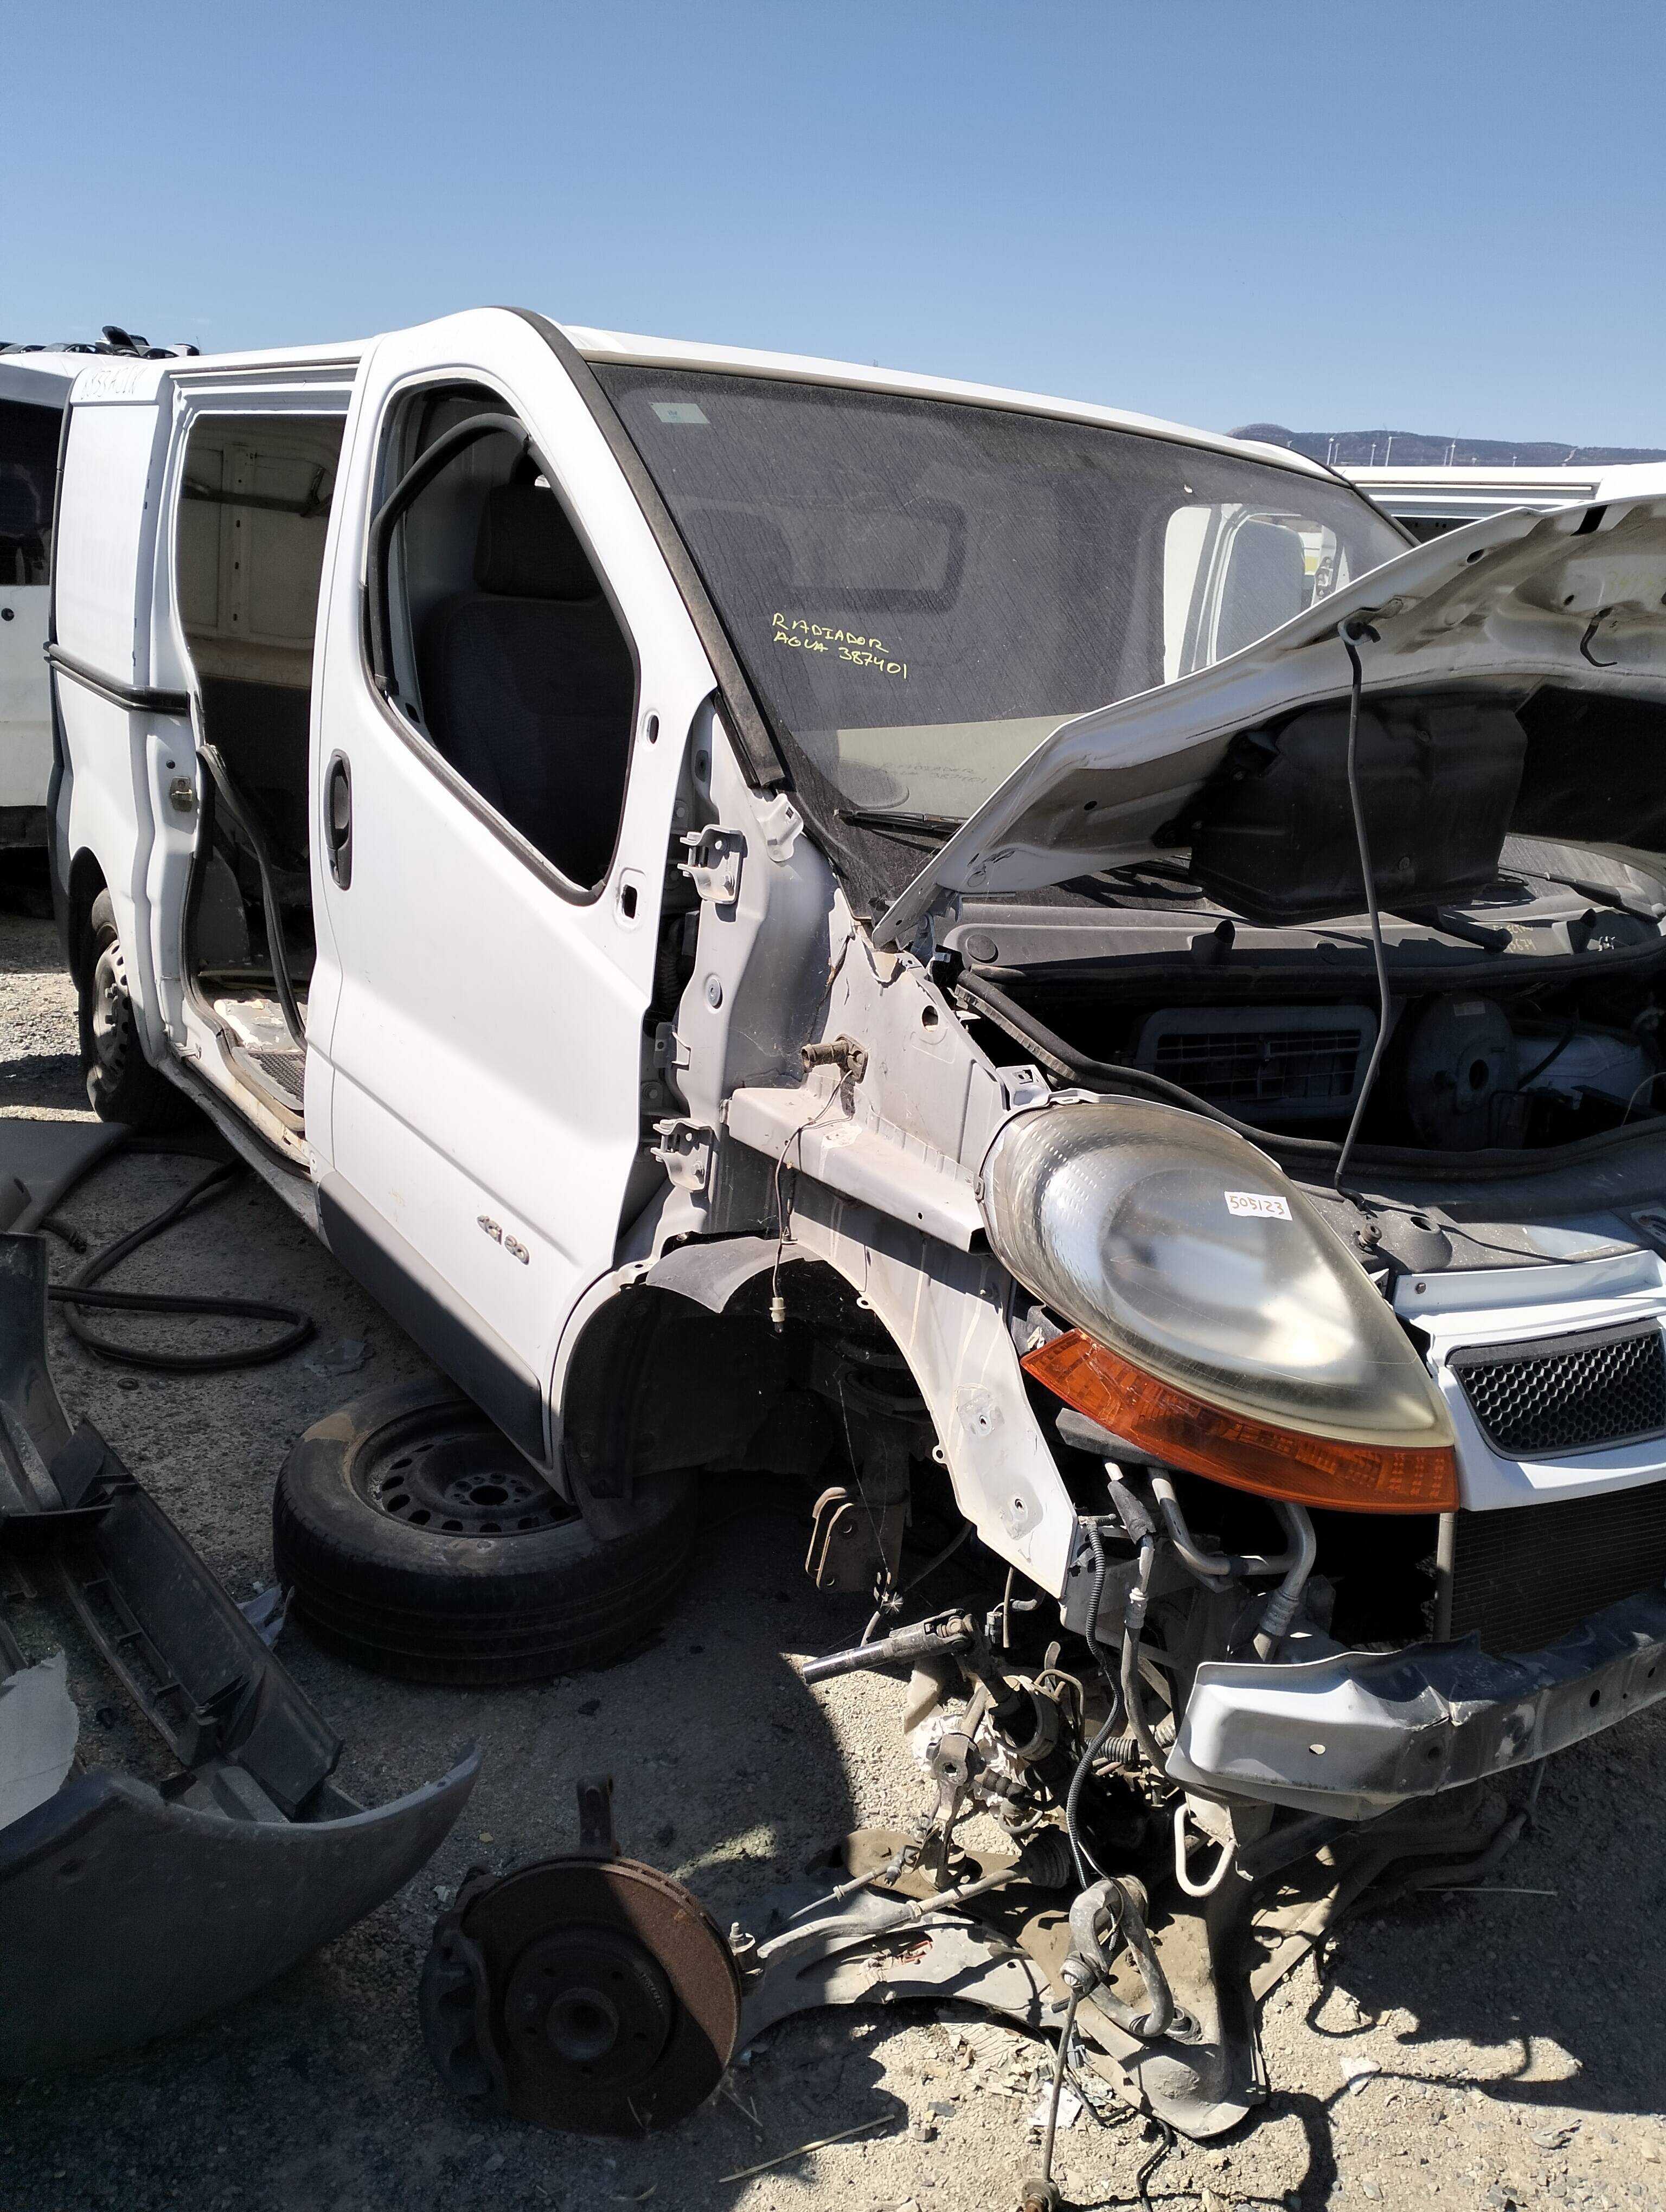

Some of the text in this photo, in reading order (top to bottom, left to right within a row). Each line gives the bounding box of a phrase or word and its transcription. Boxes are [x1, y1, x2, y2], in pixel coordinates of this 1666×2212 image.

[772, 613, 889, 653] RADIADOR
[774, 631, 907, 679] AGUA 387401
[1229, 1195, 1285, 1215] 505123
